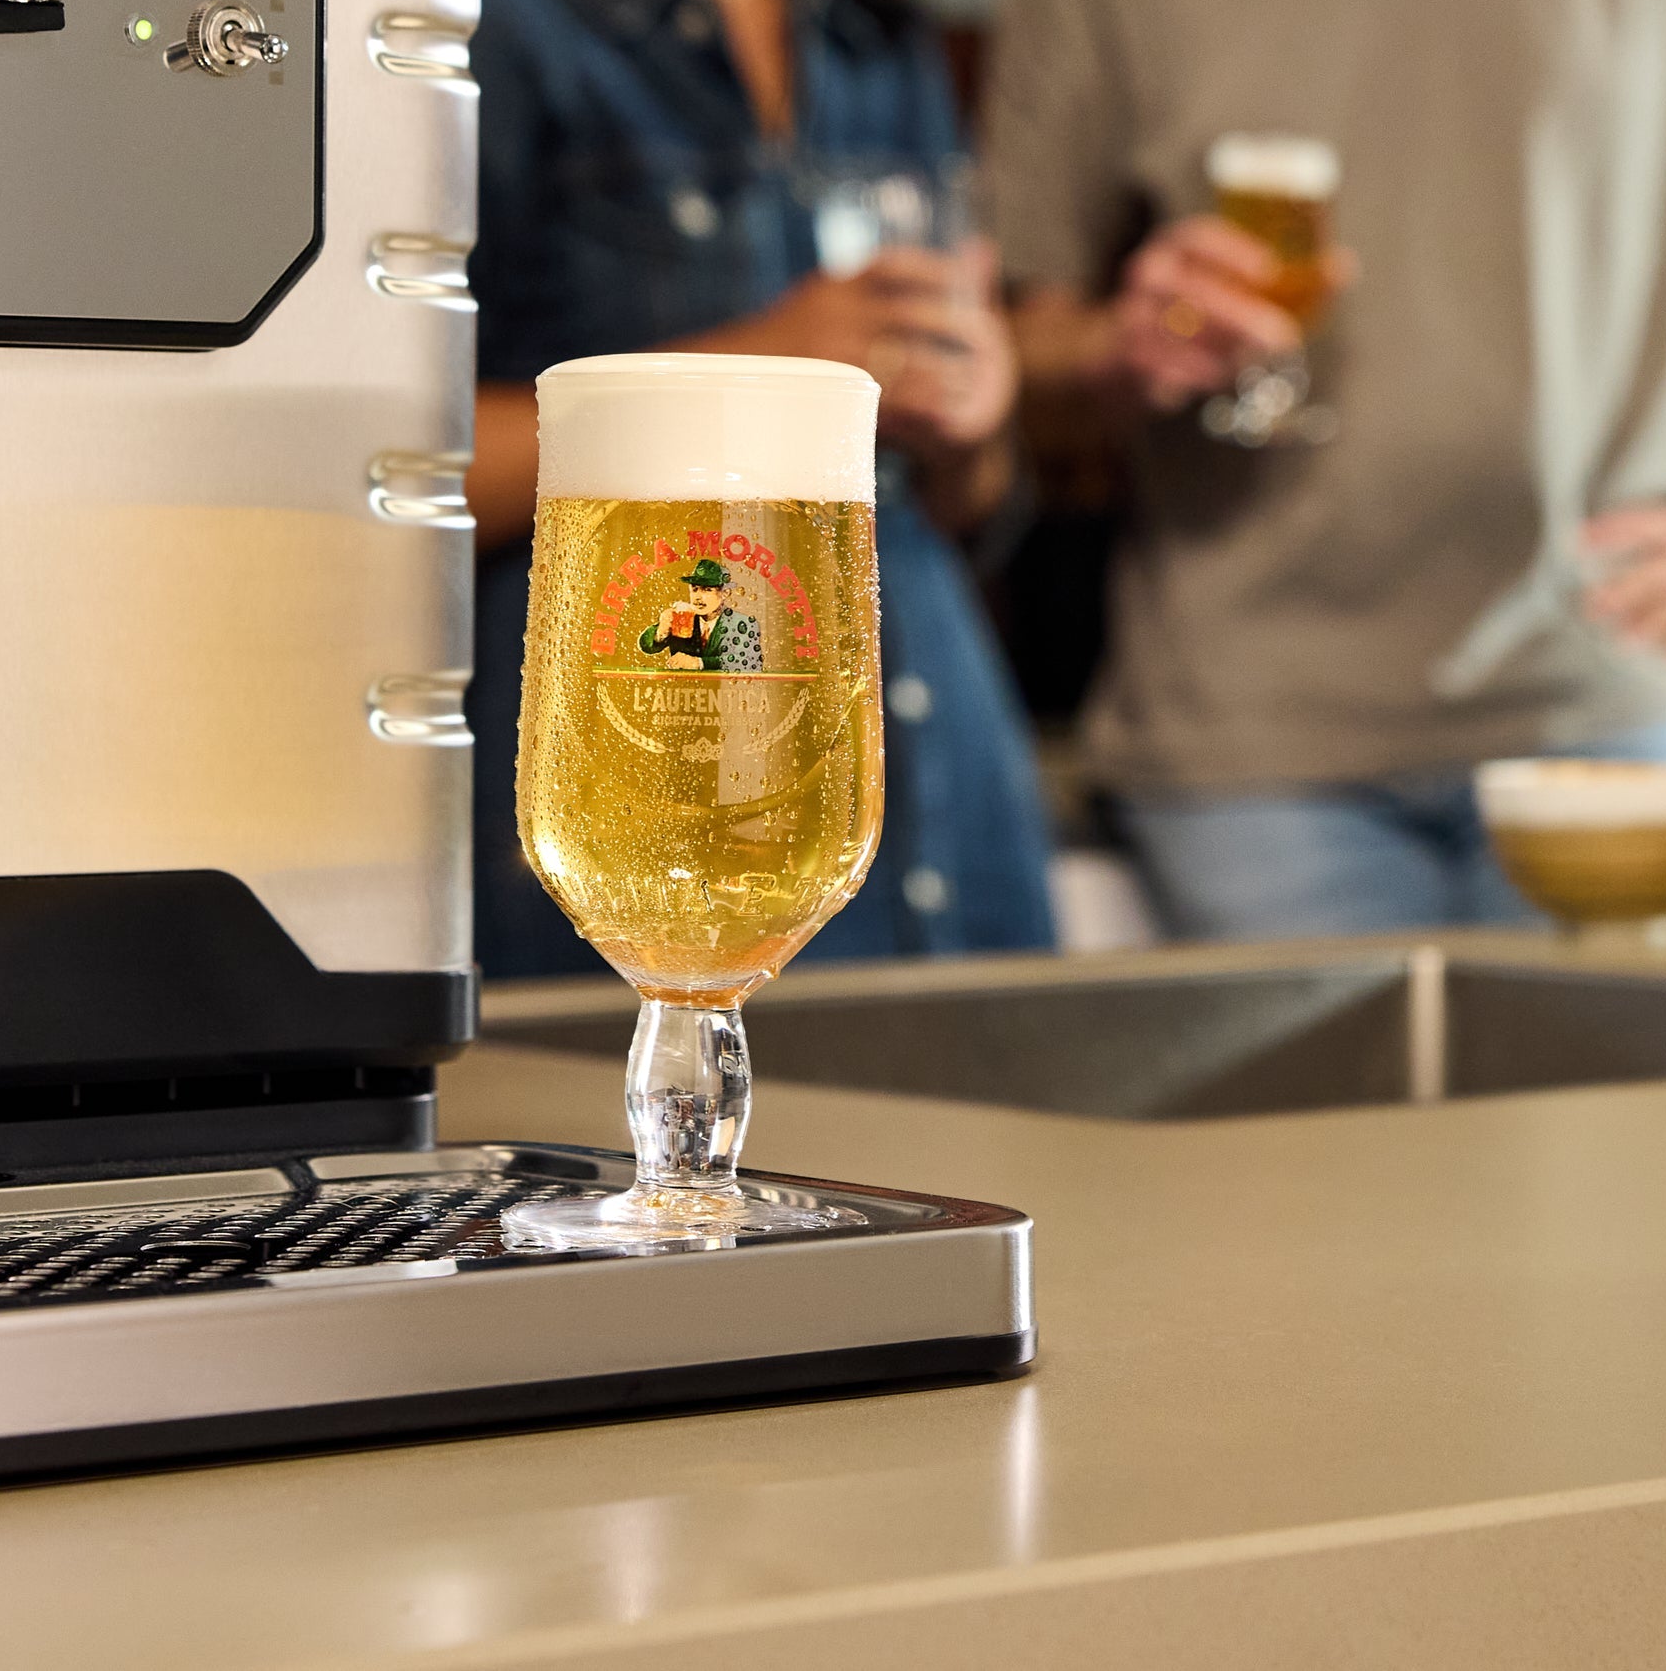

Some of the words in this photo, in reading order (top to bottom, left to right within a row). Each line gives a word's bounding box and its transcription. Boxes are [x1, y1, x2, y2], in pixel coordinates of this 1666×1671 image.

[590, 538, 682, 656] BIRRA
[686, 530, 820, 659] MORETTI
[633, 685, 771, 715] L'AUTENTICA
